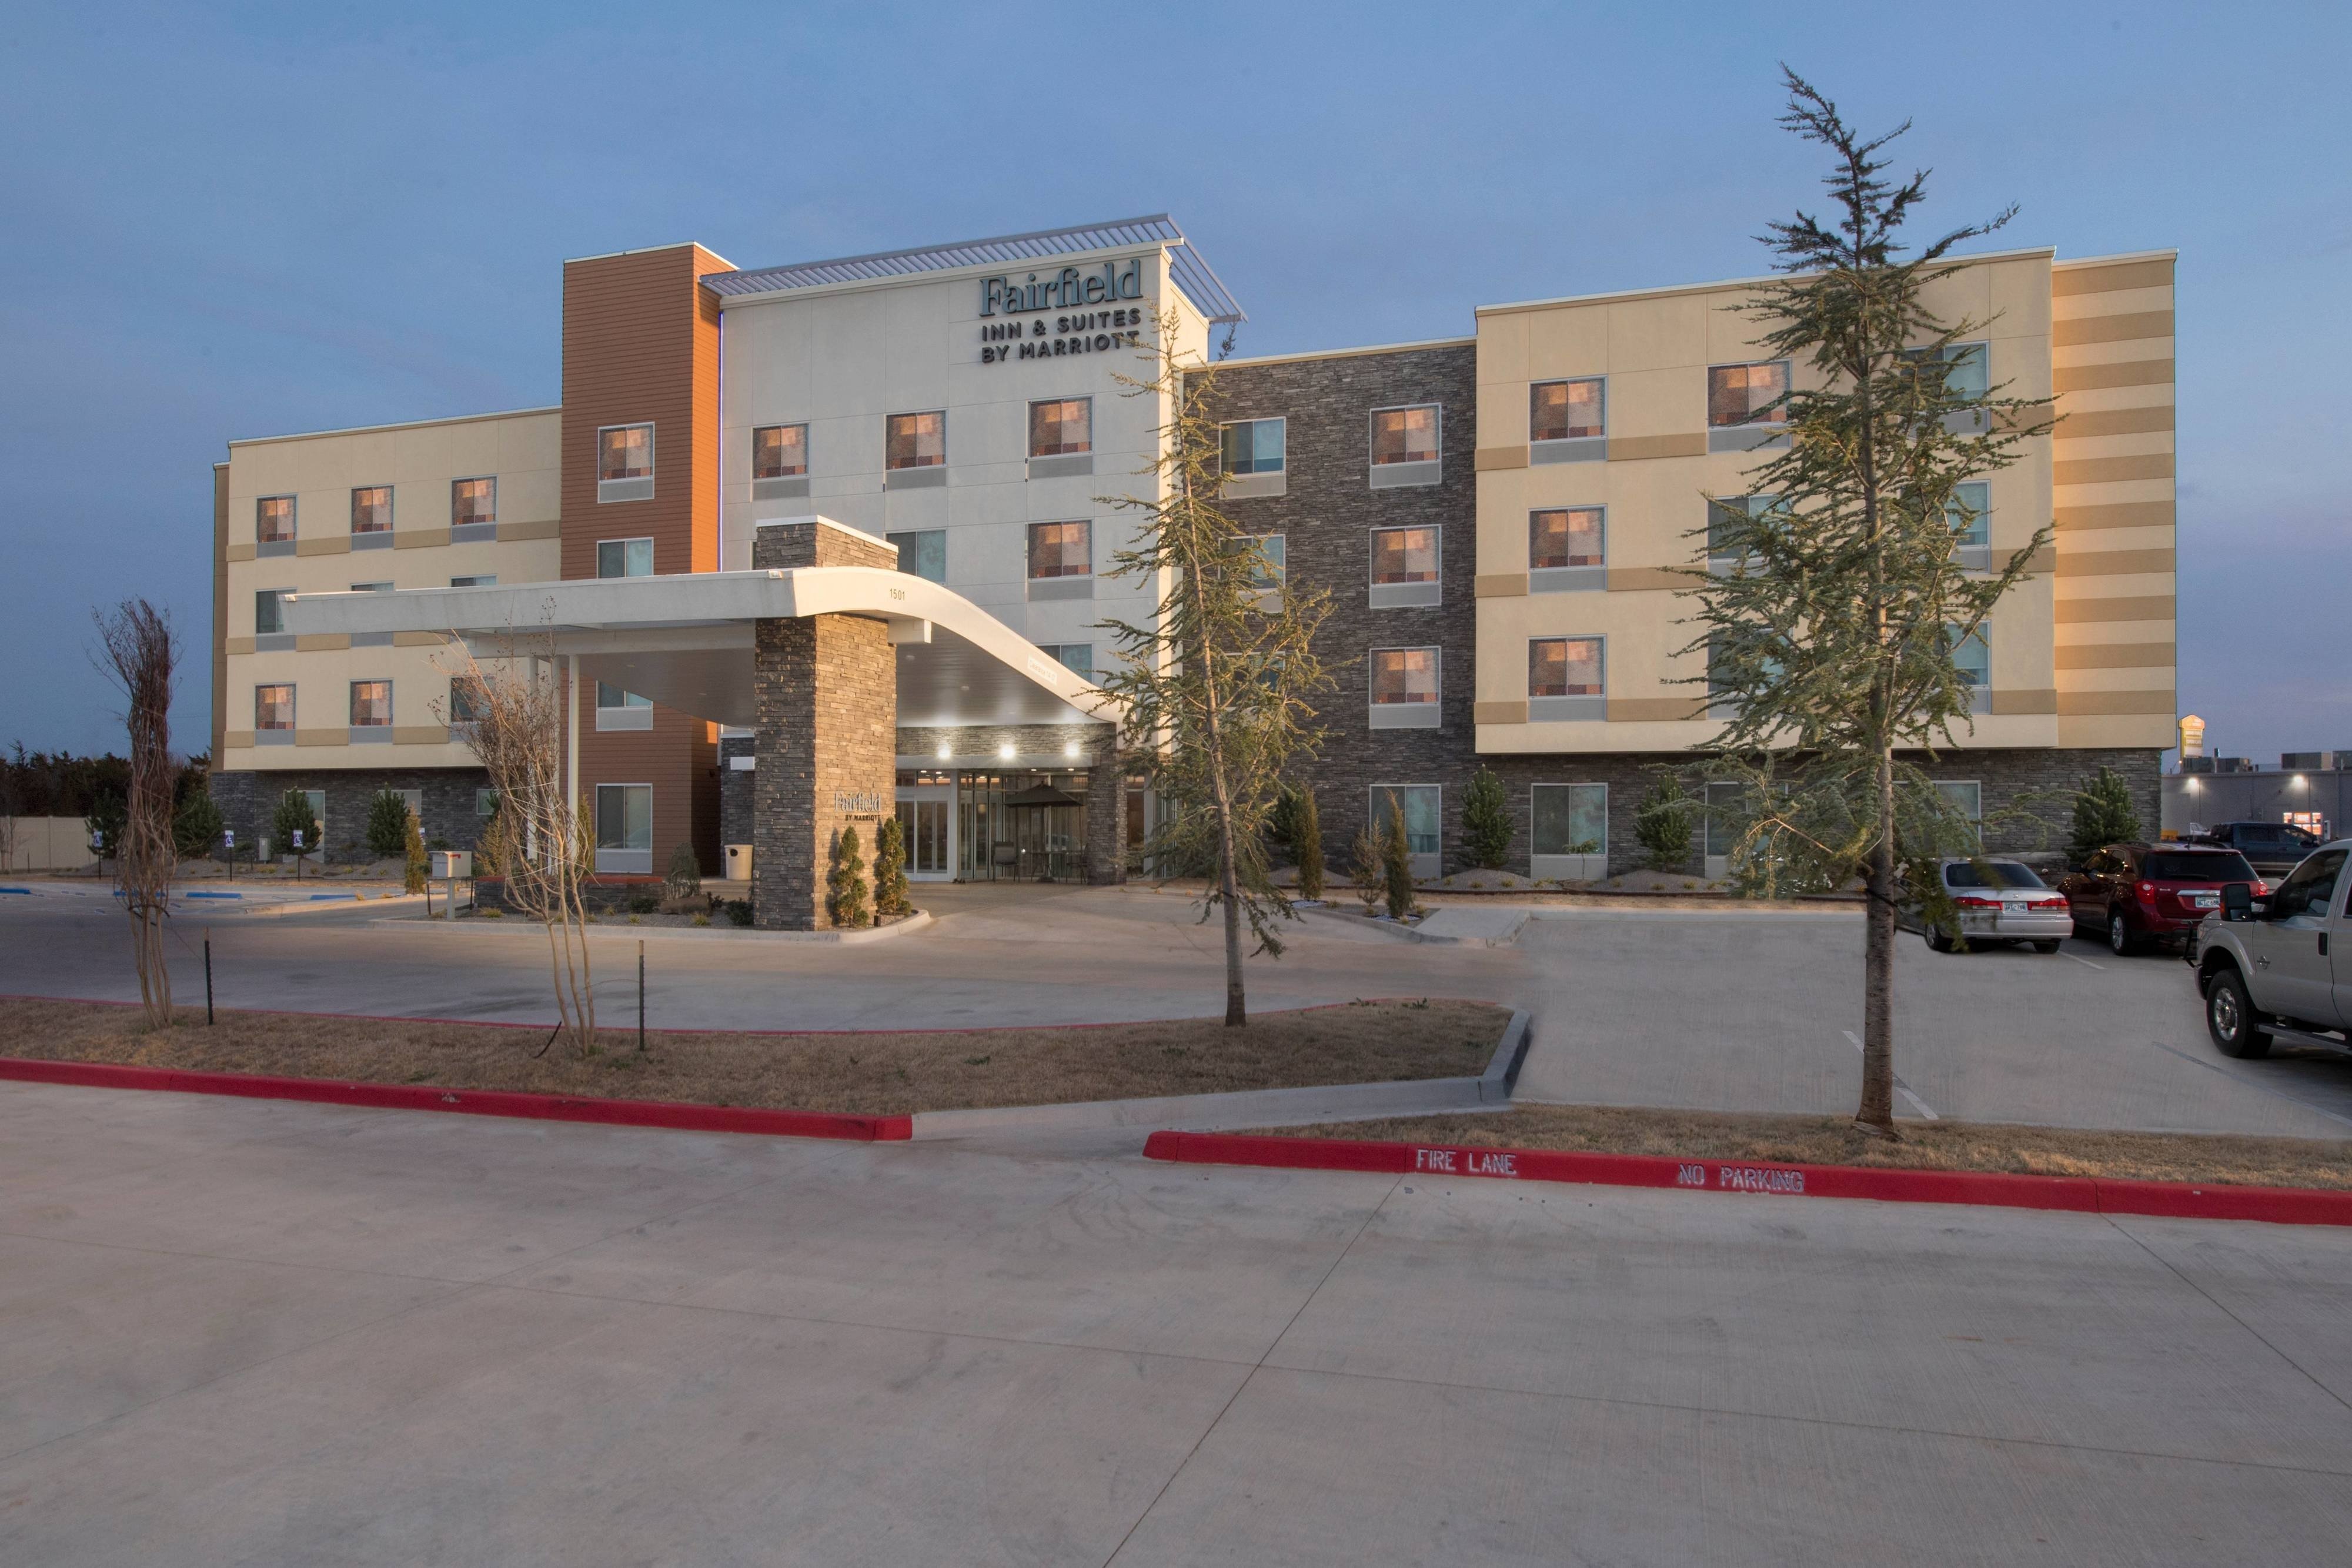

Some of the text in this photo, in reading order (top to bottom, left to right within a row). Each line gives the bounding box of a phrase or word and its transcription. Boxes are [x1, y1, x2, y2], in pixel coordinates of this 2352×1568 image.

[979, 259, 1143, 317] Fairfield
[982, 307, 1141, 342] INN & SUITES
[981, 330, 1140, 363] BY MARRIOTT
[890, 589, 905, 601] 1501
[835, 790, 881, 813] Fairfield
[1416, 1148, 1516, 1175] FIRE LANE
[1679, 1163, 1804, 1192] NO PARKING
